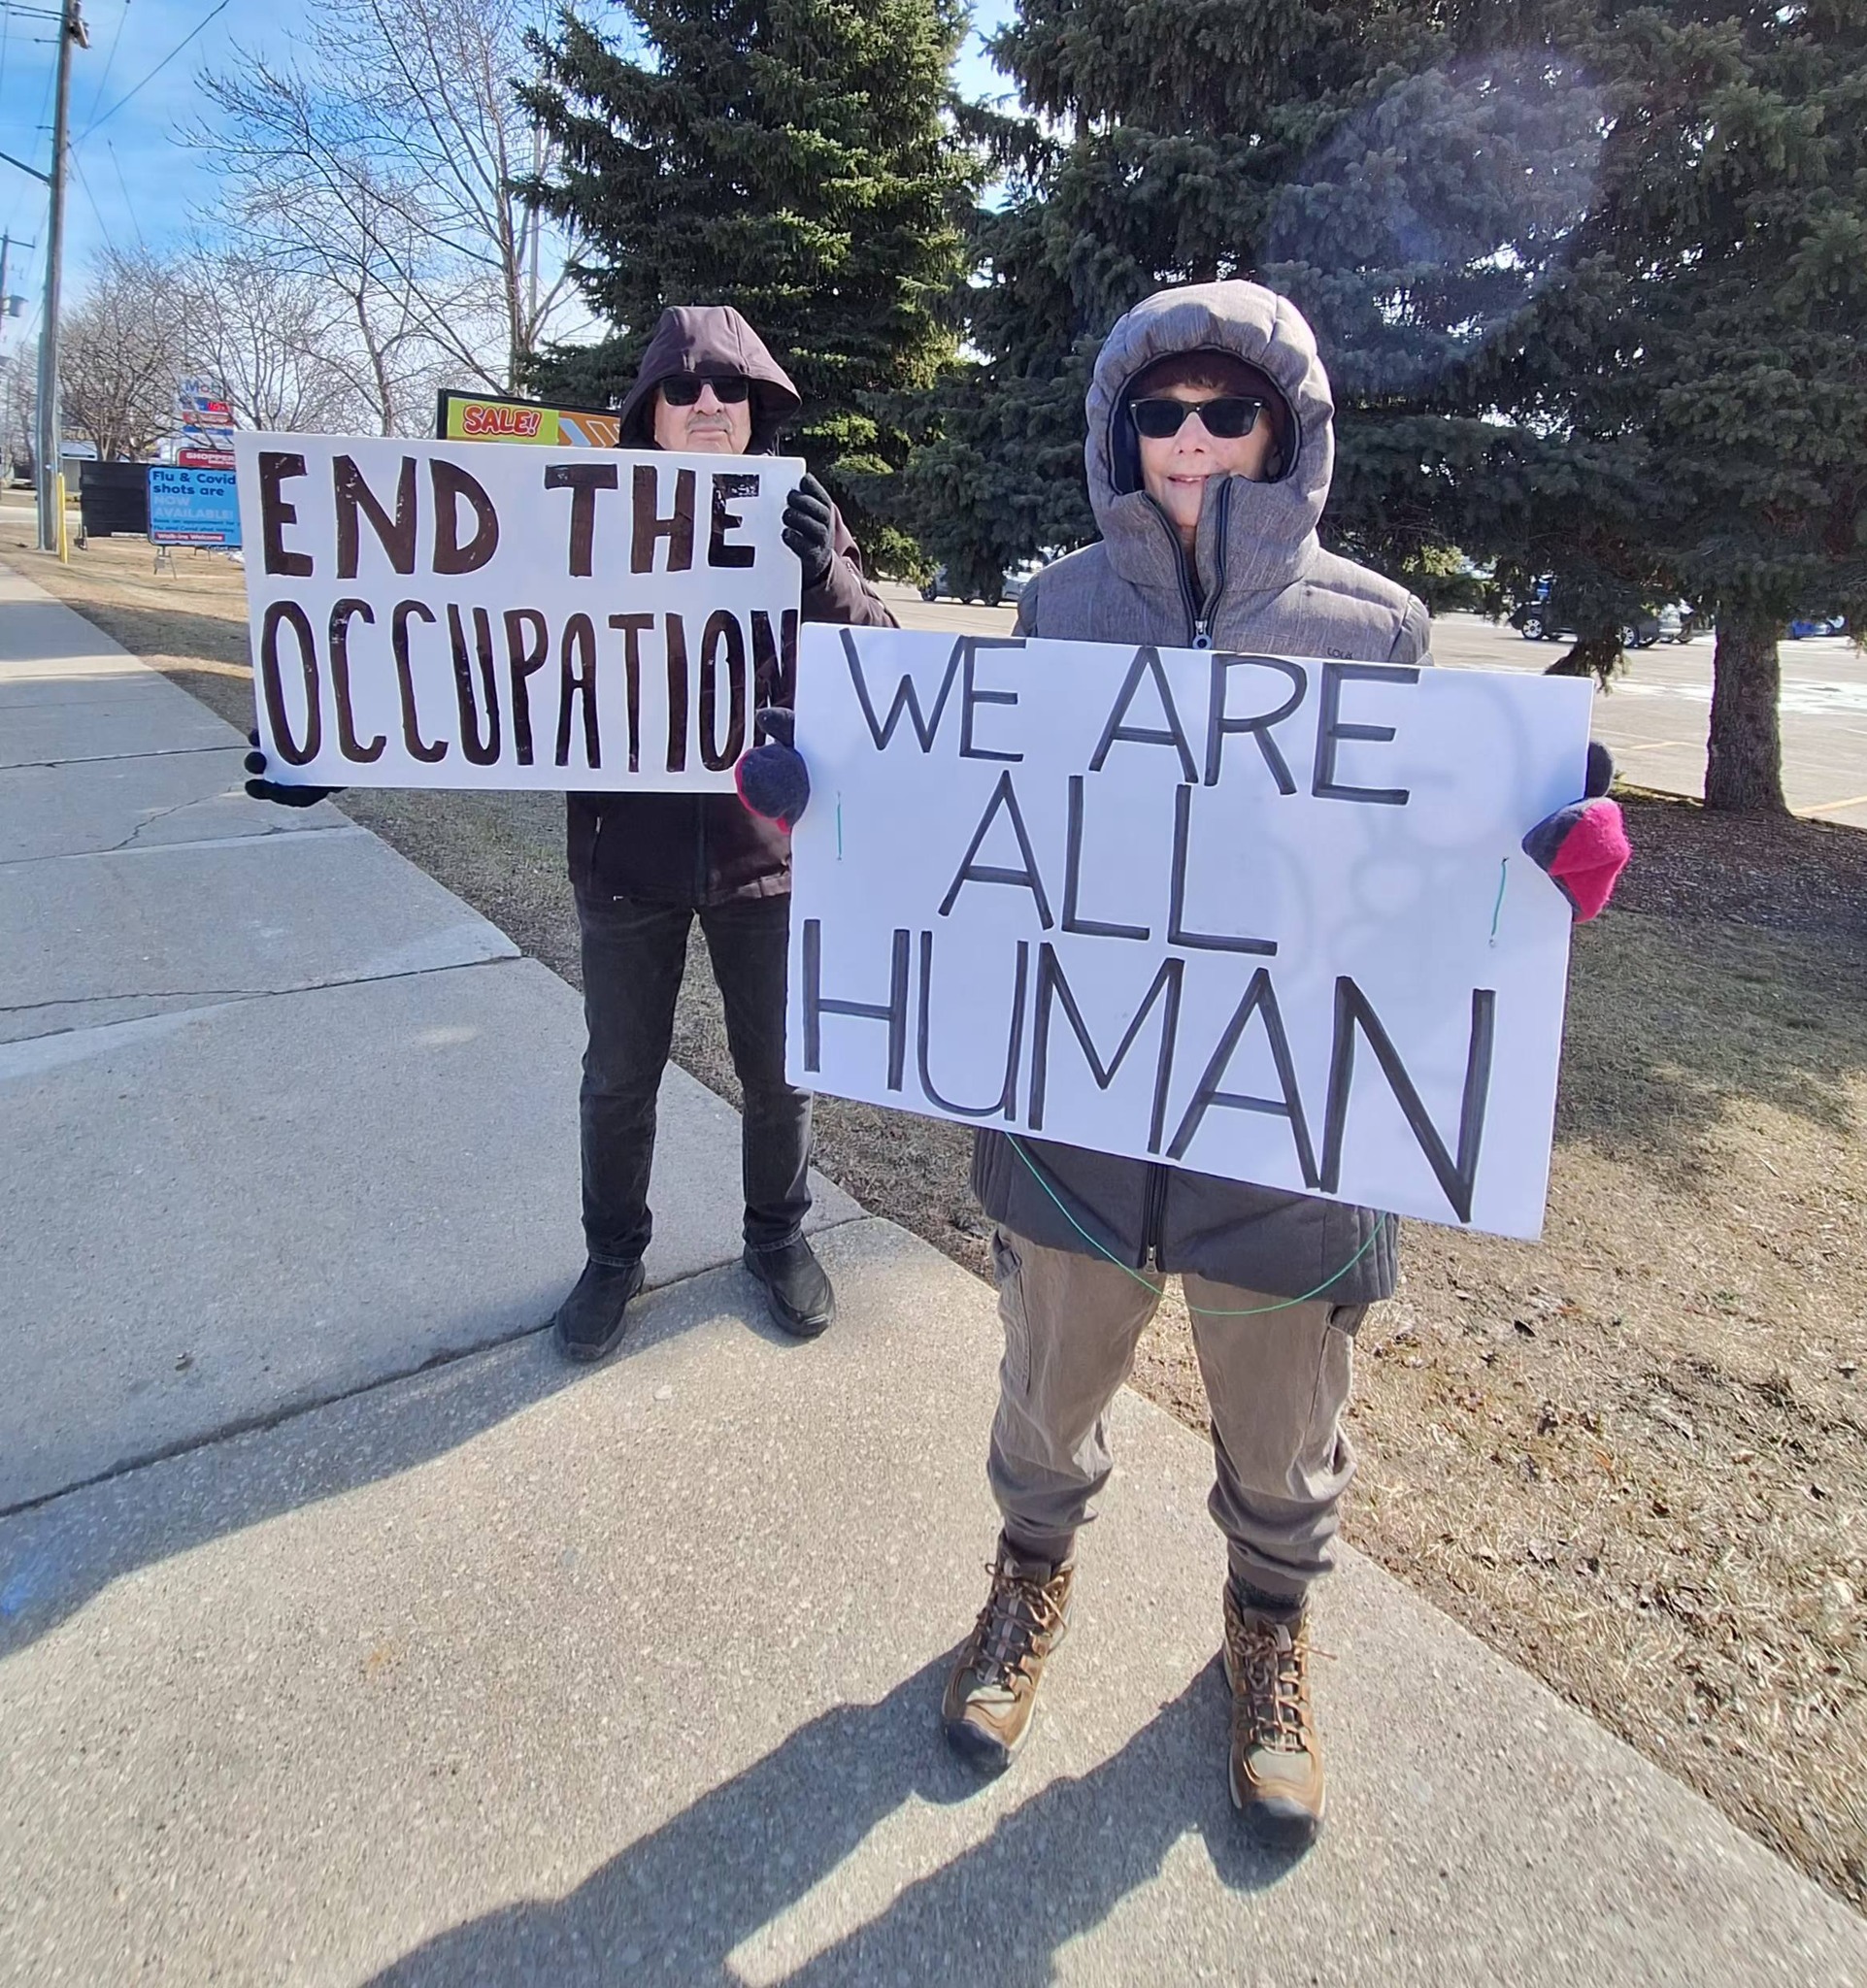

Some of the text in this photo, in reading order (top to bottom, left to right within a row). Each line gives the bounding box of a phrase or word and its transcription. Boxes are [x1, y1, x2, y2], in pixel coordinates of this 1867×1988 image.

[152, 471, 236, 485] Flu & Covid
[463, 404, 543, 438] SALE!
[152, 483, 224, 496] shots are
[154, 495, 191, 506] NOW
[258, 451, 760, 580] END THE
[260, 598, 799, 773] OCCUPATION
[839, 627, 1421, 807] WE ARE
[937, 769, 1278, 956] ALL
[801, 918, 1496, 1224] HUMAN
